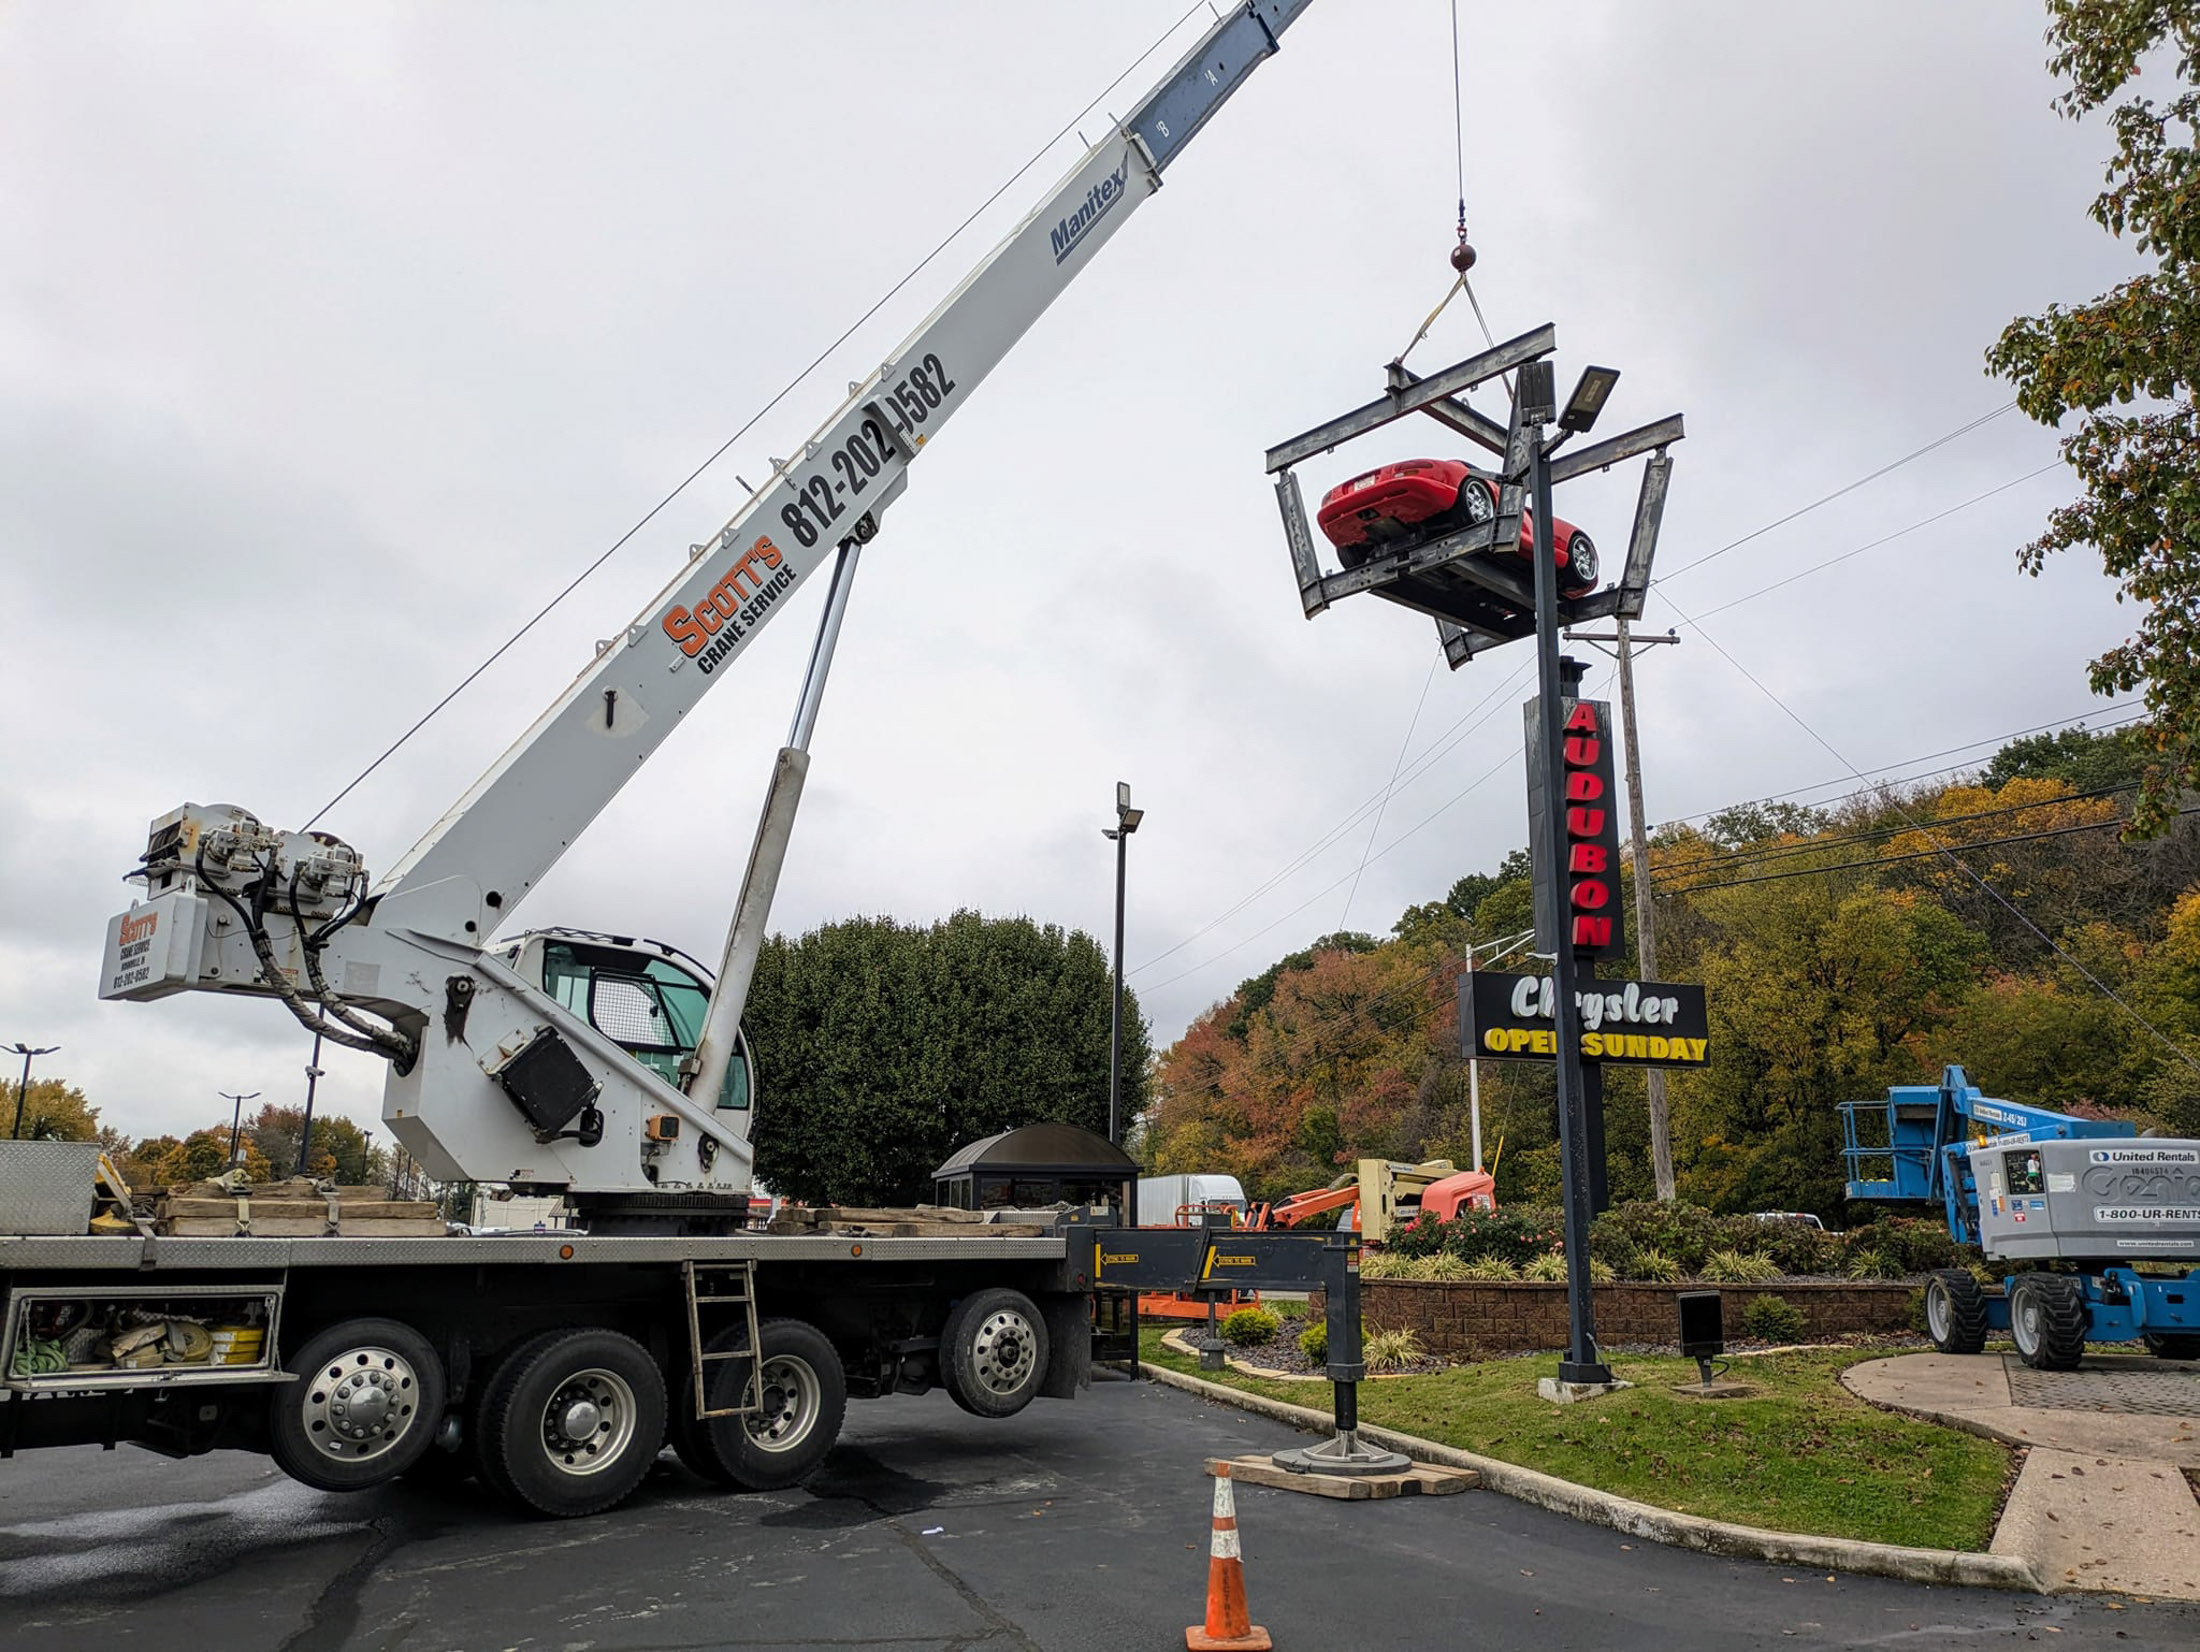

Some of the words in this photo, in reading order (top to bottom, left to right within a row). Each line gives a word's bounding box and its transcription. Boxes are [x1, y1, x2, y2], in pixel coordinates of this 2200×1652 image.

[1050, 164, 1127, 256] Manitex
[697, 622, 746, 675] CRANE
[743, 563, 797, 627] SERVICE
[1563, 703, 1613, 947] AUDUBON
[1511, 975, 1679, 1031] Chysler
[1580, 1032, 1708, 1062] SUNDAY
[2112, 1151, 2154, 1162] United
[2157, 1151, 2196, 1162] Rentals
